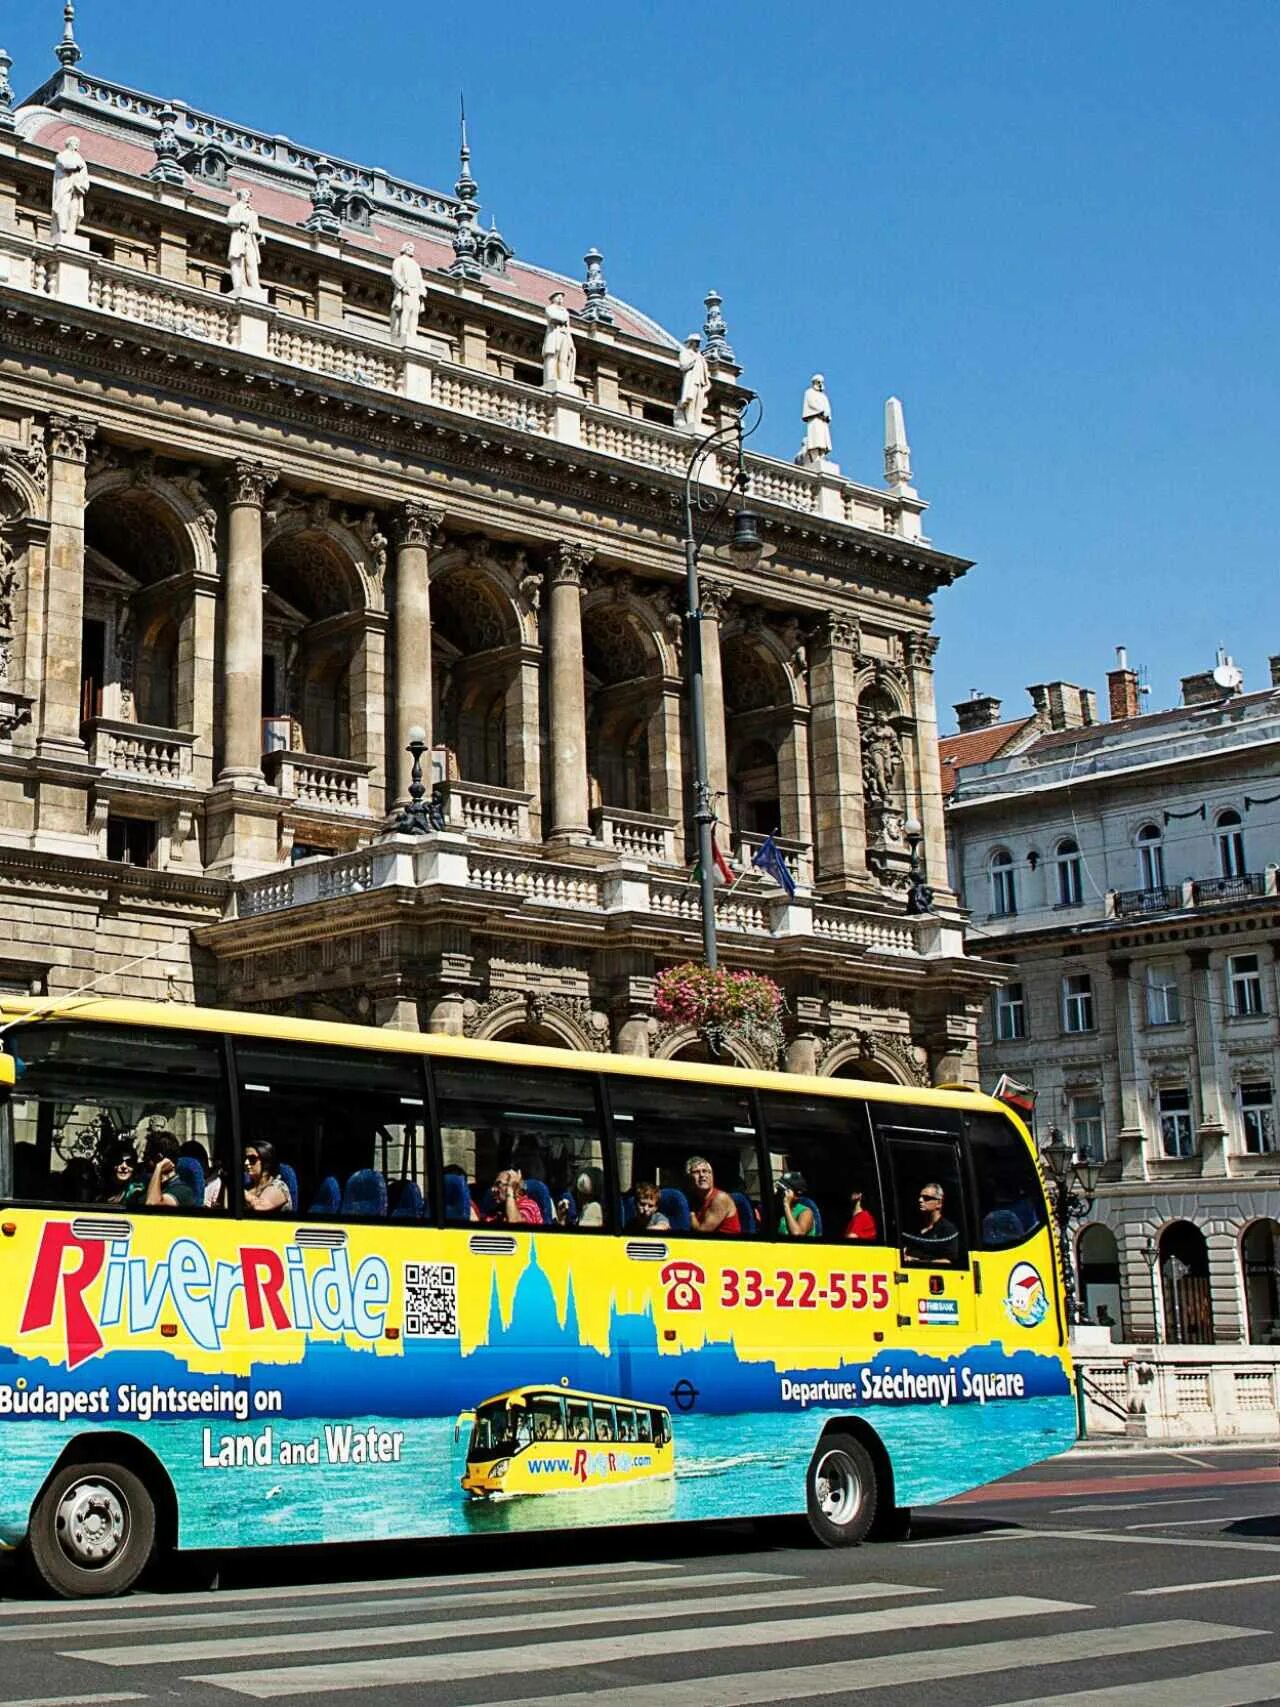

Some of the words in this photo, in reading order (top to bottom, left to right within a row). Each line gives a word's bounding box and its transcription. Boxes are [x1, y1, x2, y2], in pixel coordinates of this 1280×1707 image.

[20, 1221, 390, 1370] RiverRide
[720, 1269, 889, 1309] 33-22-555
[117, 1384, 249, 1420] Sightseeing
[253, 1389, 283, 1412] on
[780, 1378, 857, 1407] Departure:
[860, 1366, 957, 1407] Széchenyi
[961, 1367, 1025, 1405] Square
[202, 1424, 273, 1468] Land
[279, 1438, 320, 1466] and
[322, 1423, 405, 1464] Water
